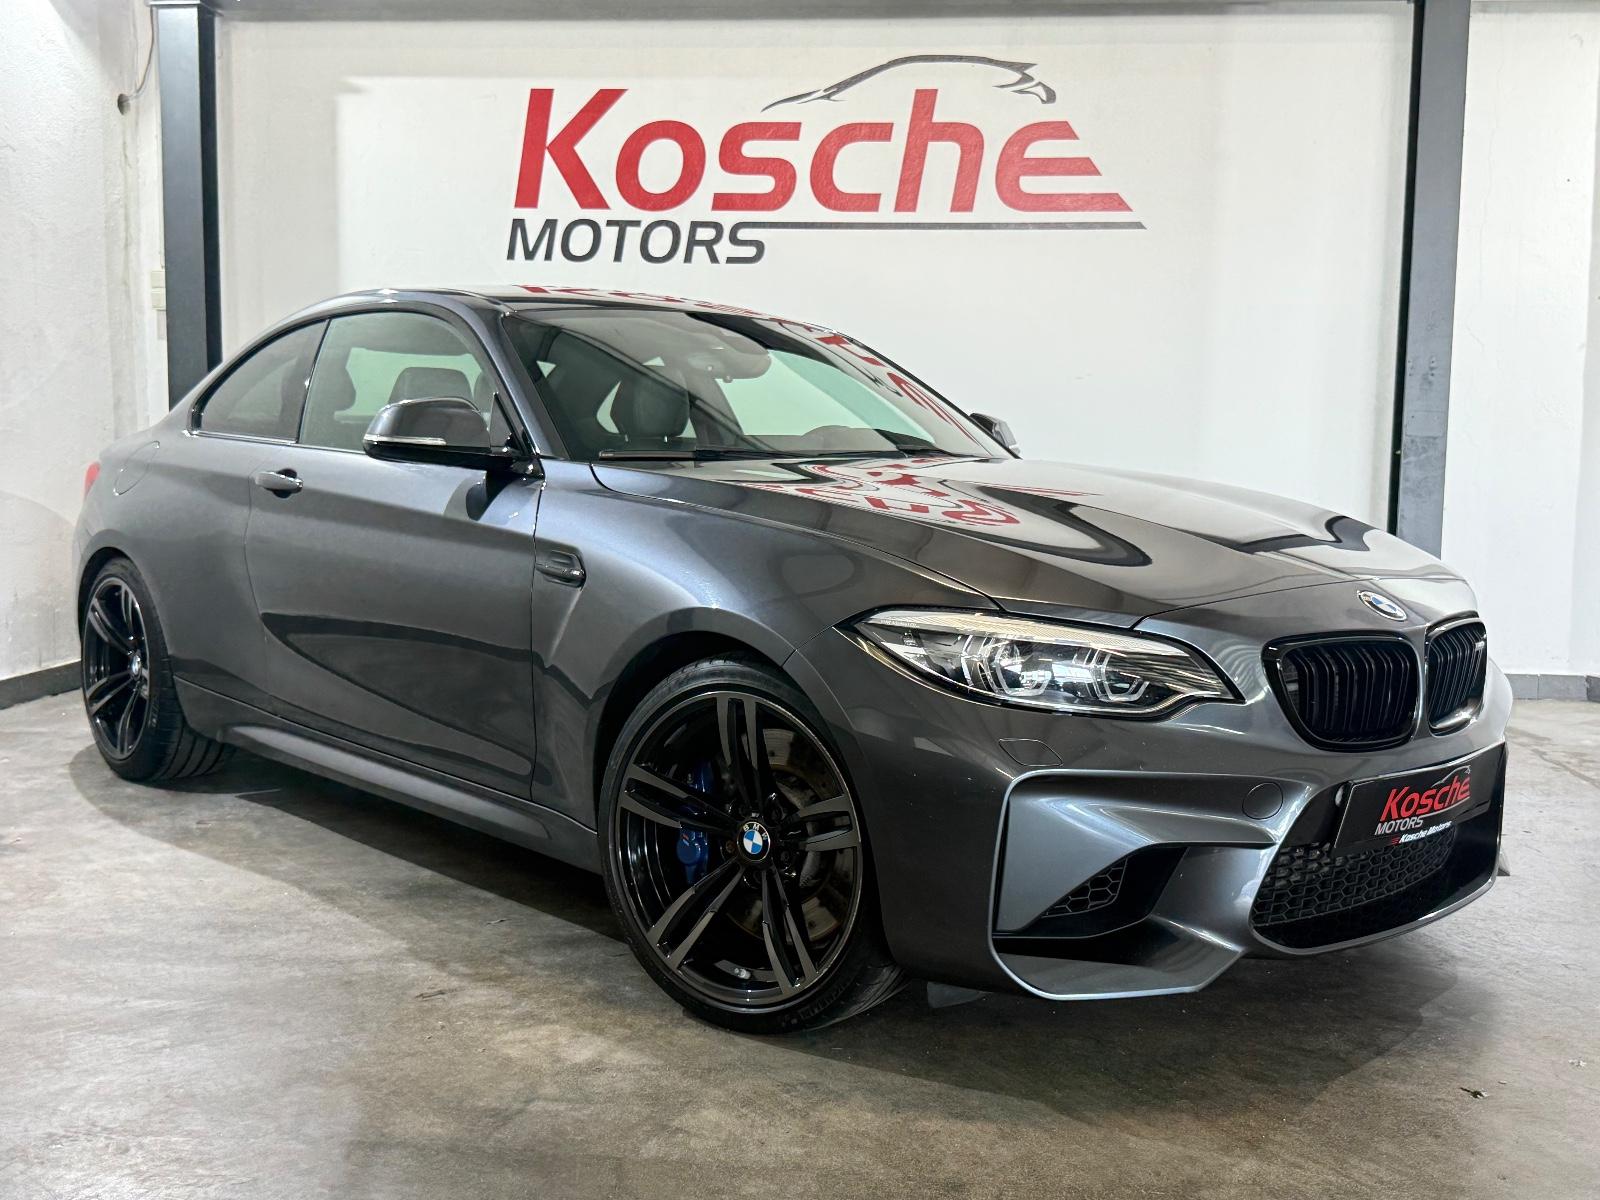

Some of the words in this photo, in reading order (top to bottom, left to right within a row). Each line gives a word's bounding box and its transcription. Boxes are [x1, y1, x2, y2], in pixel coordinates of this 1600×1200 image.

[513, 87, 1133, 213] Kosche
[506, 218, 766, 264] MOTORS
[1379, 775, 1471, 822] Kosche
[1374, 815, 1424, 836] MOTORS
[1398, 830, 1428, 844] Kosche
[1426, 820, 1453, 836] Motors
